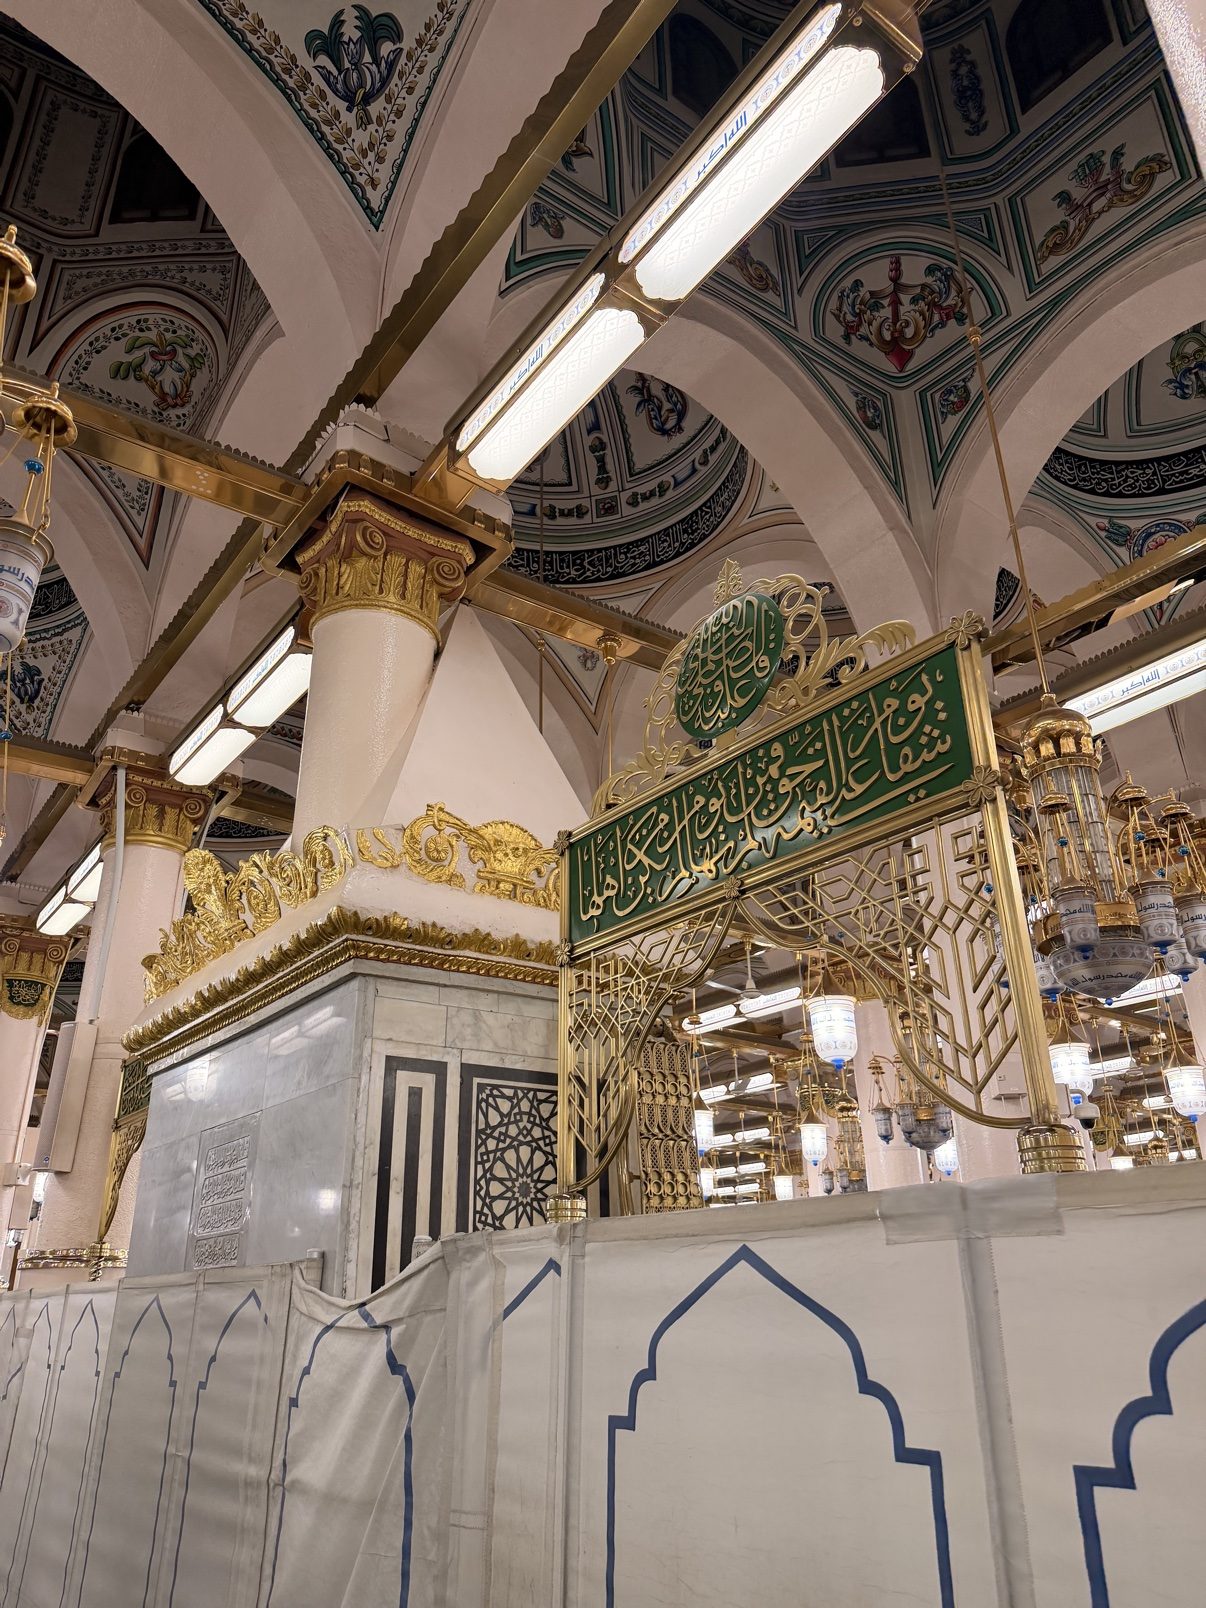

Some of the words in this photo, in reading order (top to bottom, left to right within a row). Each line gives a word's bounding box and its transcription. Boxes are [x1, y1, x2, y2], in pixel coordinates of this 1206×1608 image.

[728, 111, 747, 142] الله
[530, 344, 544, 368] الله
[1146, 669, 1161, 683] الله
